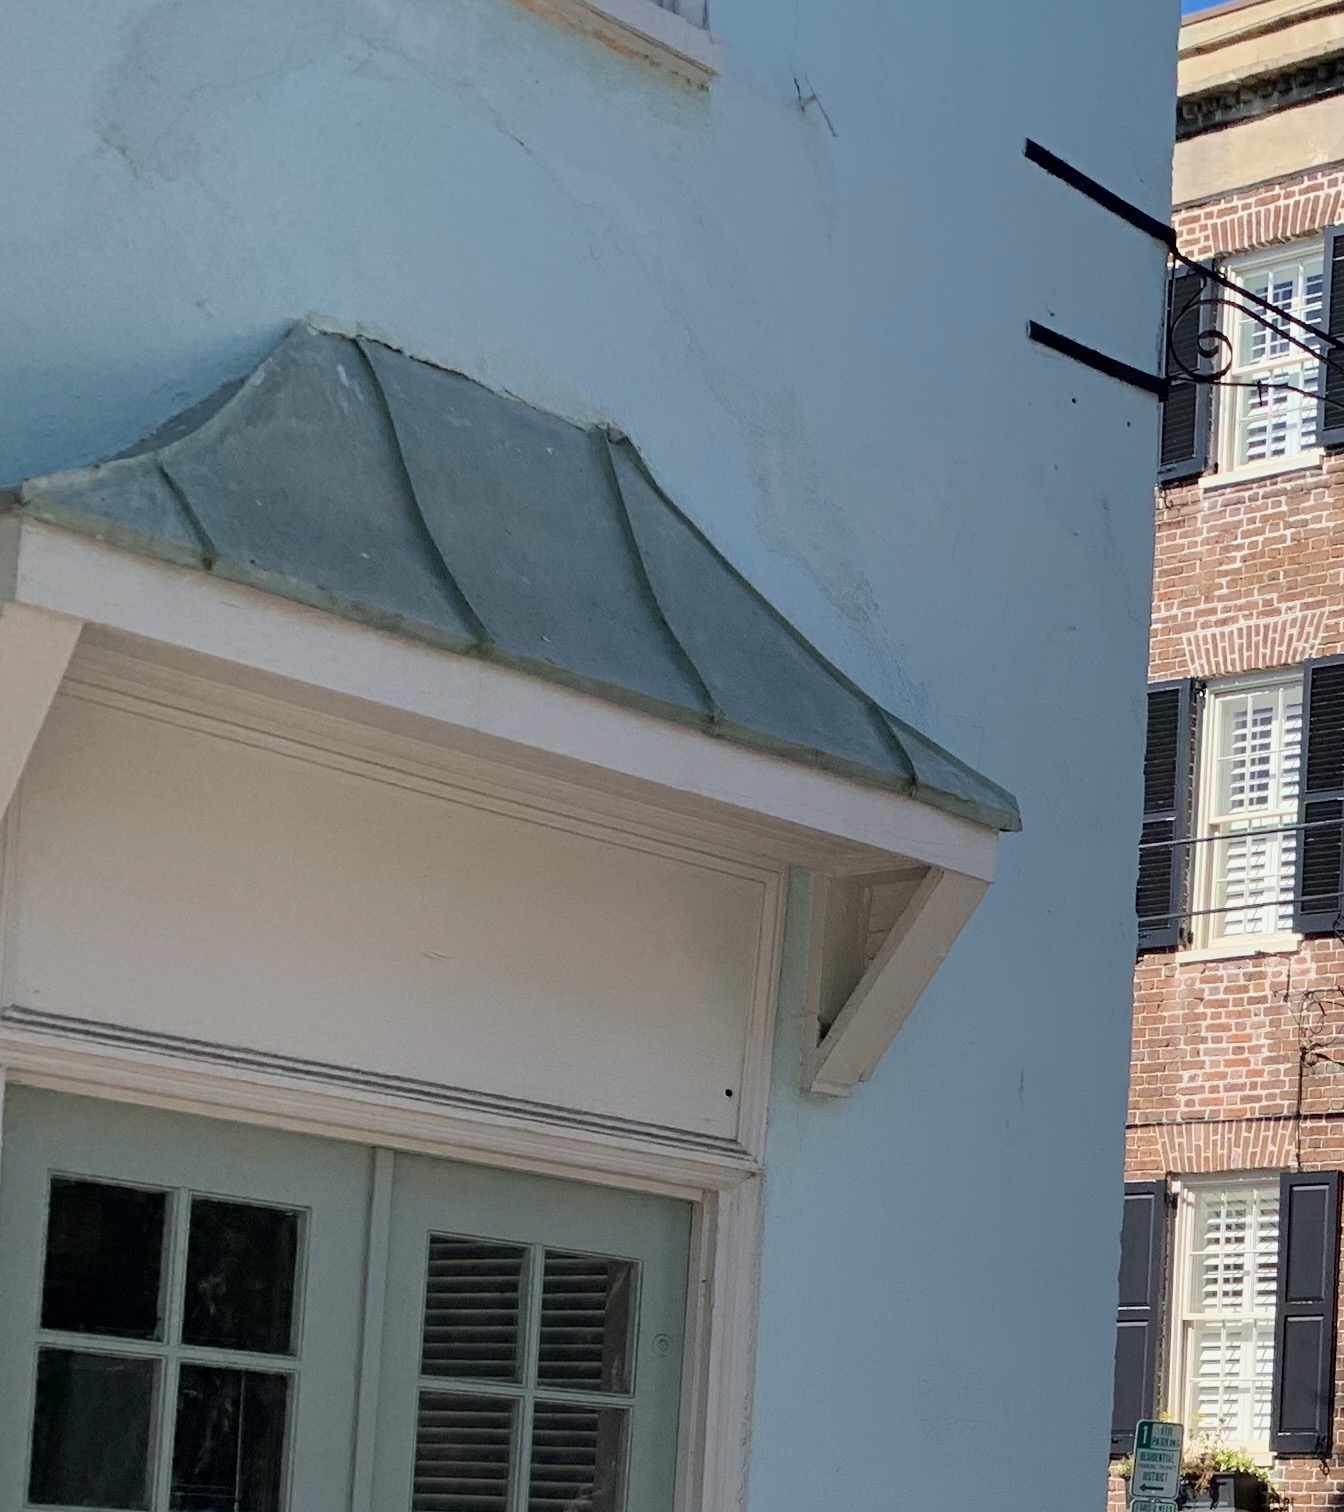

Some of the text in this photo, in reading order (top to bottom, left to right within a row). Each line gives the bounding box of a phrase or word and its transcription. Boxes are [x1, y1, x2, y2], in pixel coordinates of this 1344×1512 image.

[1143, 1425, 1149, 1444] 1
[1152, 1436, 1181, 1448] PARKING
[1139, 1451, 1175, 1463] RESIDENTIAL
[1142, 1471, 1168, 1482] DISTRICT
[1158, 1505, 1173, 1512] WEEK
